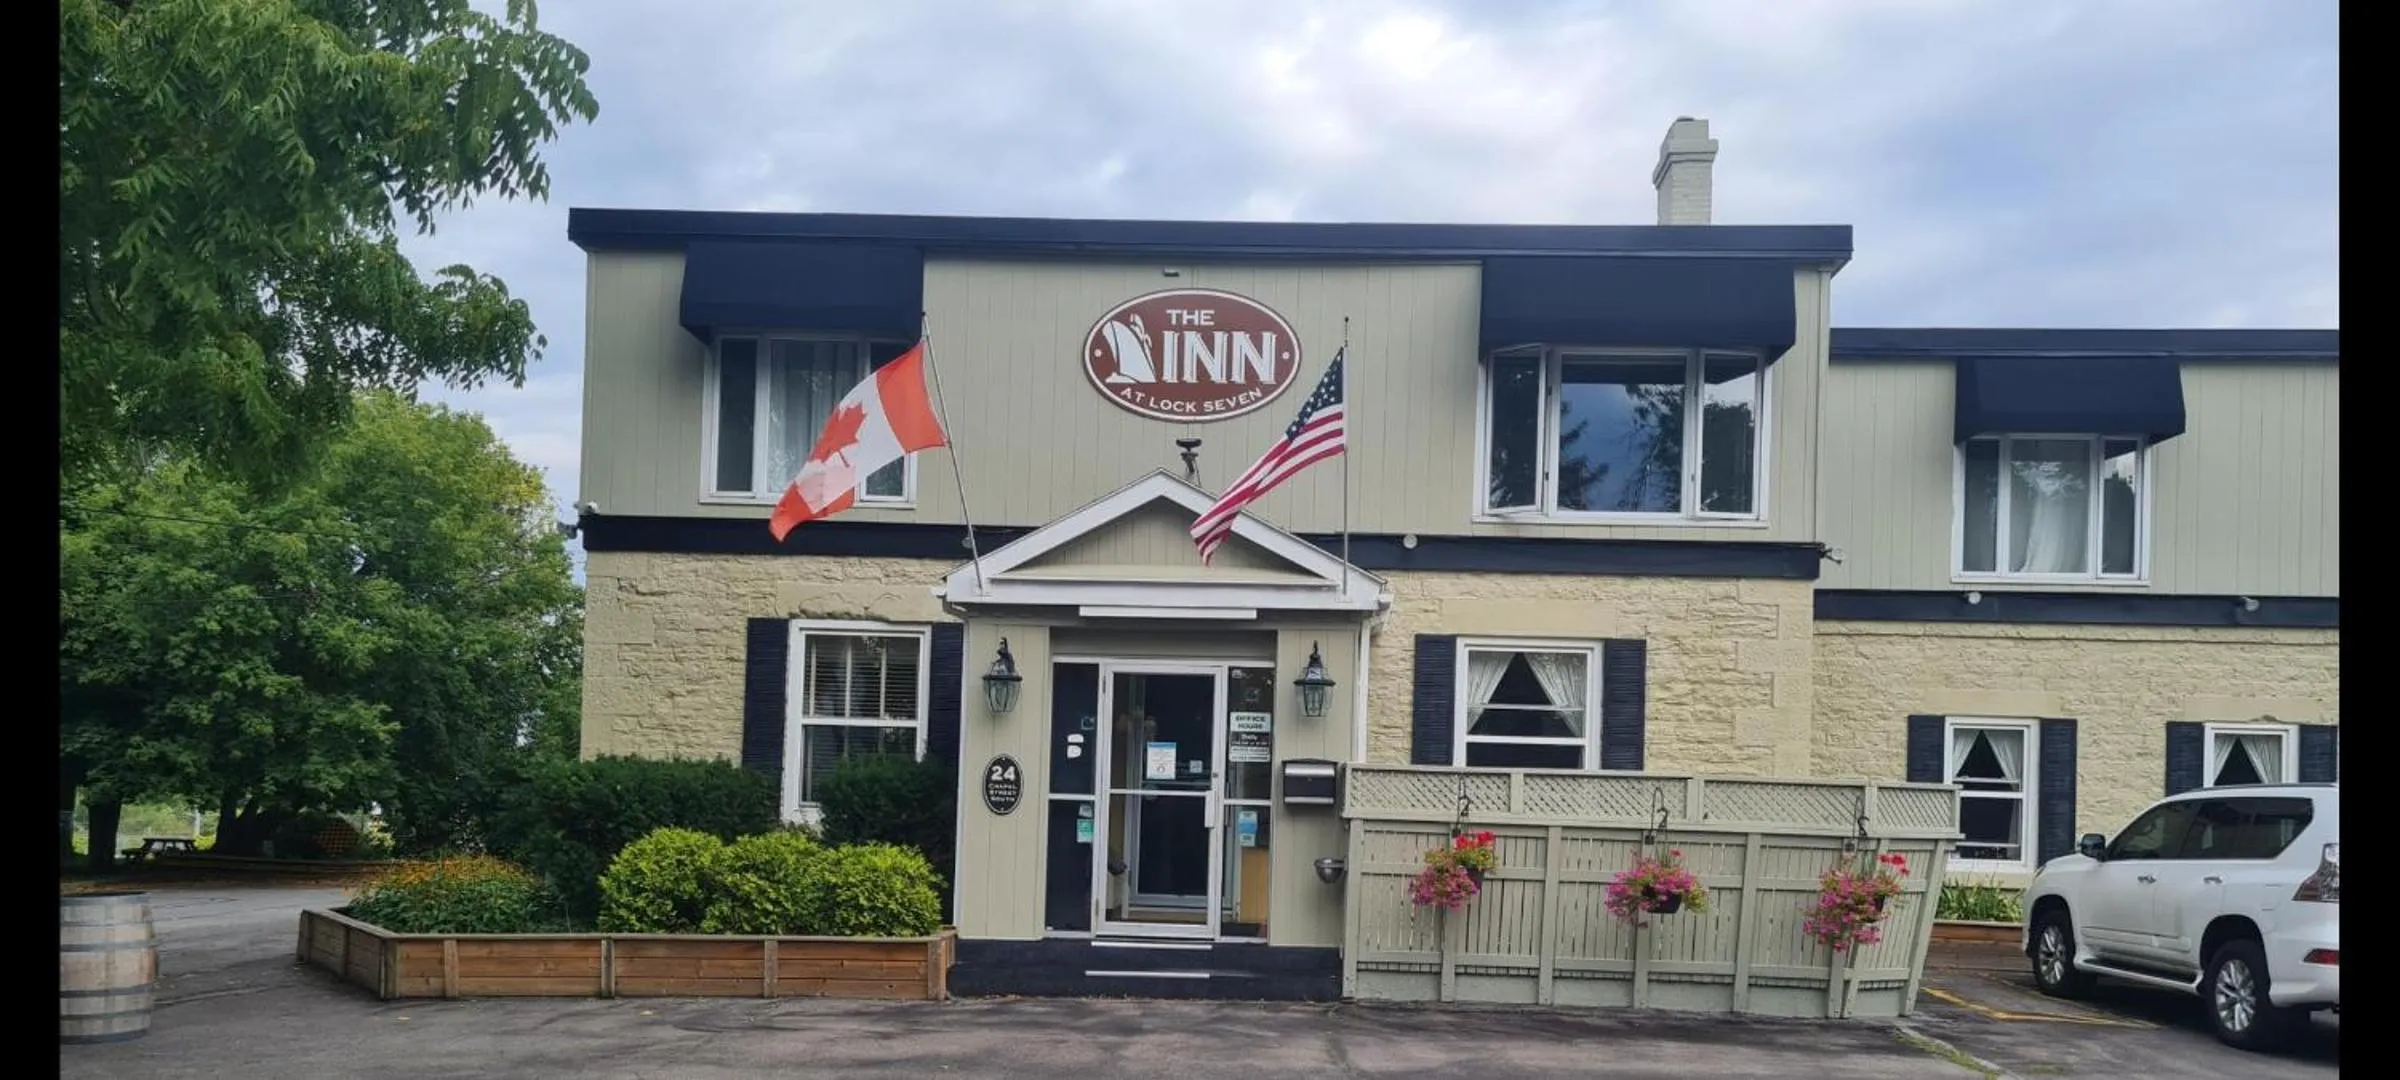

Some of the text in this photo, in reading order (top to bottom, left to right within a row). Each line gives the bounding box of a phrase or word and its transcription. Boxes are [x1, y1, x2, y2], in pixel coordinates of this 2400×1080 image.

[1166, 309, 1215, 326] THE
[1162, 330, 1278, 385] INN
[1120, 387, 1264, 413] AT LOCK SEVEN
[991, 765, 1016, 781] 24
